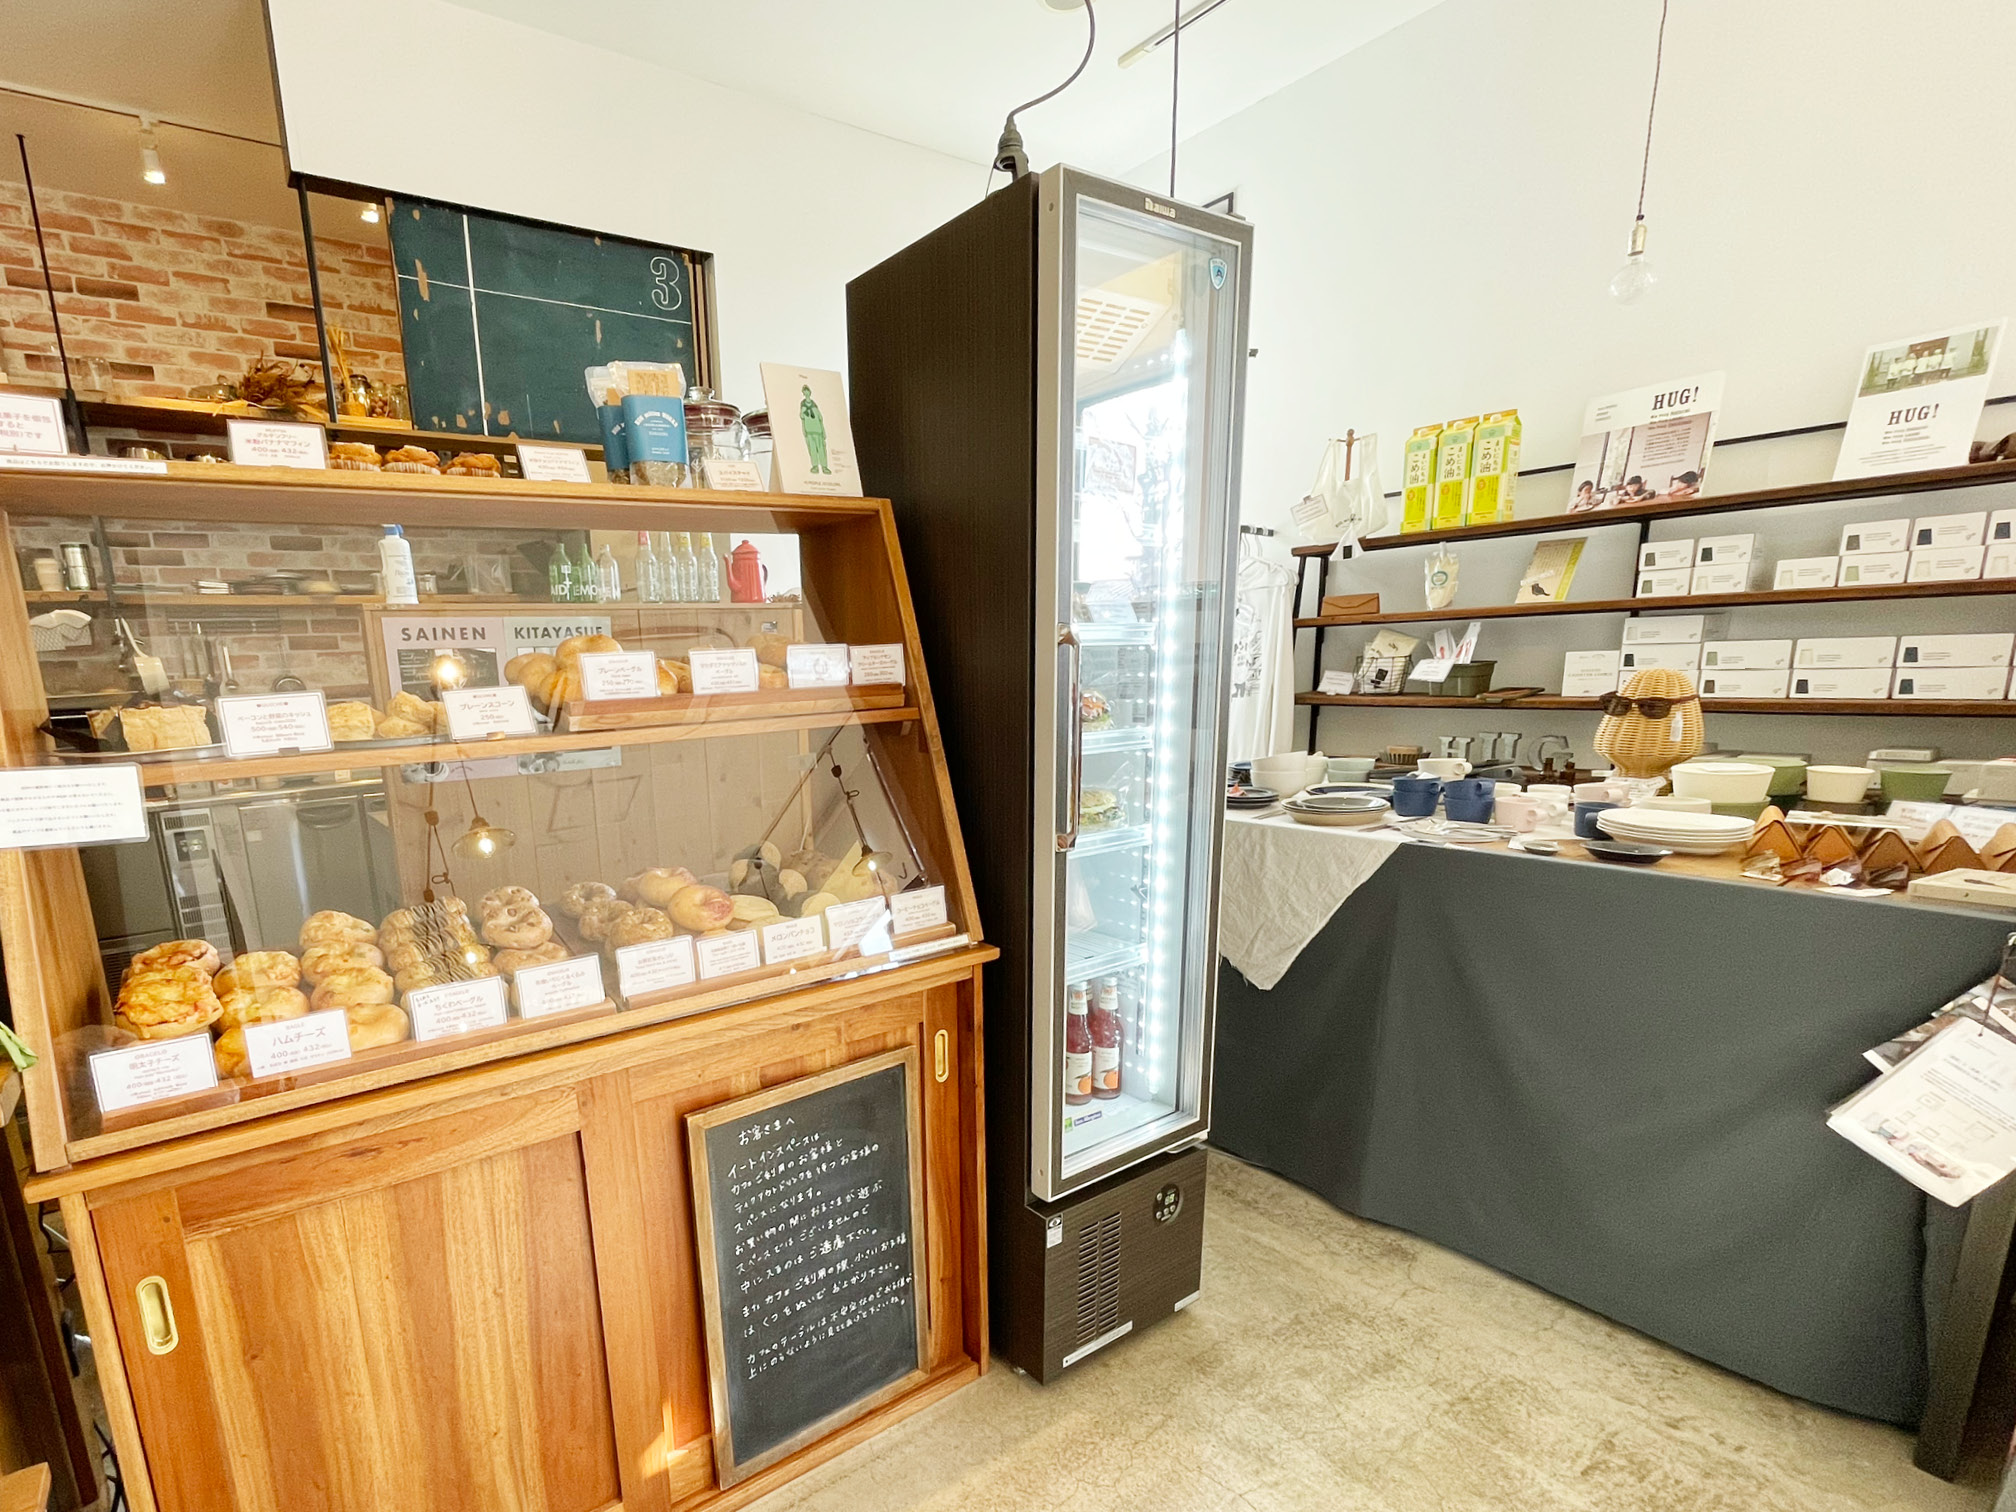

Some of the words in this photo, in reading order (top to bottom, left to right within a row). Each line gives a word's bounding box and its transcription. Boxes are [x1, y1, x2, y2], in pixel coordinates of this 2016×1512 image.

[650, 256, 682, 311] 3
[1652, 386, 1699, 411] HUG!
[1887, 403, 1939, 426] HUG!
[1409, 454, 1420, 485] こめ油
[1444, 447, 1455, 479] こめ油
[1480, 441, 1492, 473] こめ油
[401, 627, 486, 641] SAINEN
[460, 700, 515, 711] プレーンスコーン
[435, 996, 484, 1011] ちくわベーグル
[272, 1026, 326, 1047] ハムチーズ
[270, 1050, 288, 1059] 400
[303, 1043, 320, 1052] 432
[738, 1117, 795, 1146] お客さまへ
[728, 1132, 820, 1180] イートインスペースは
[734, 1187, 822, 1235] スペースになります。
